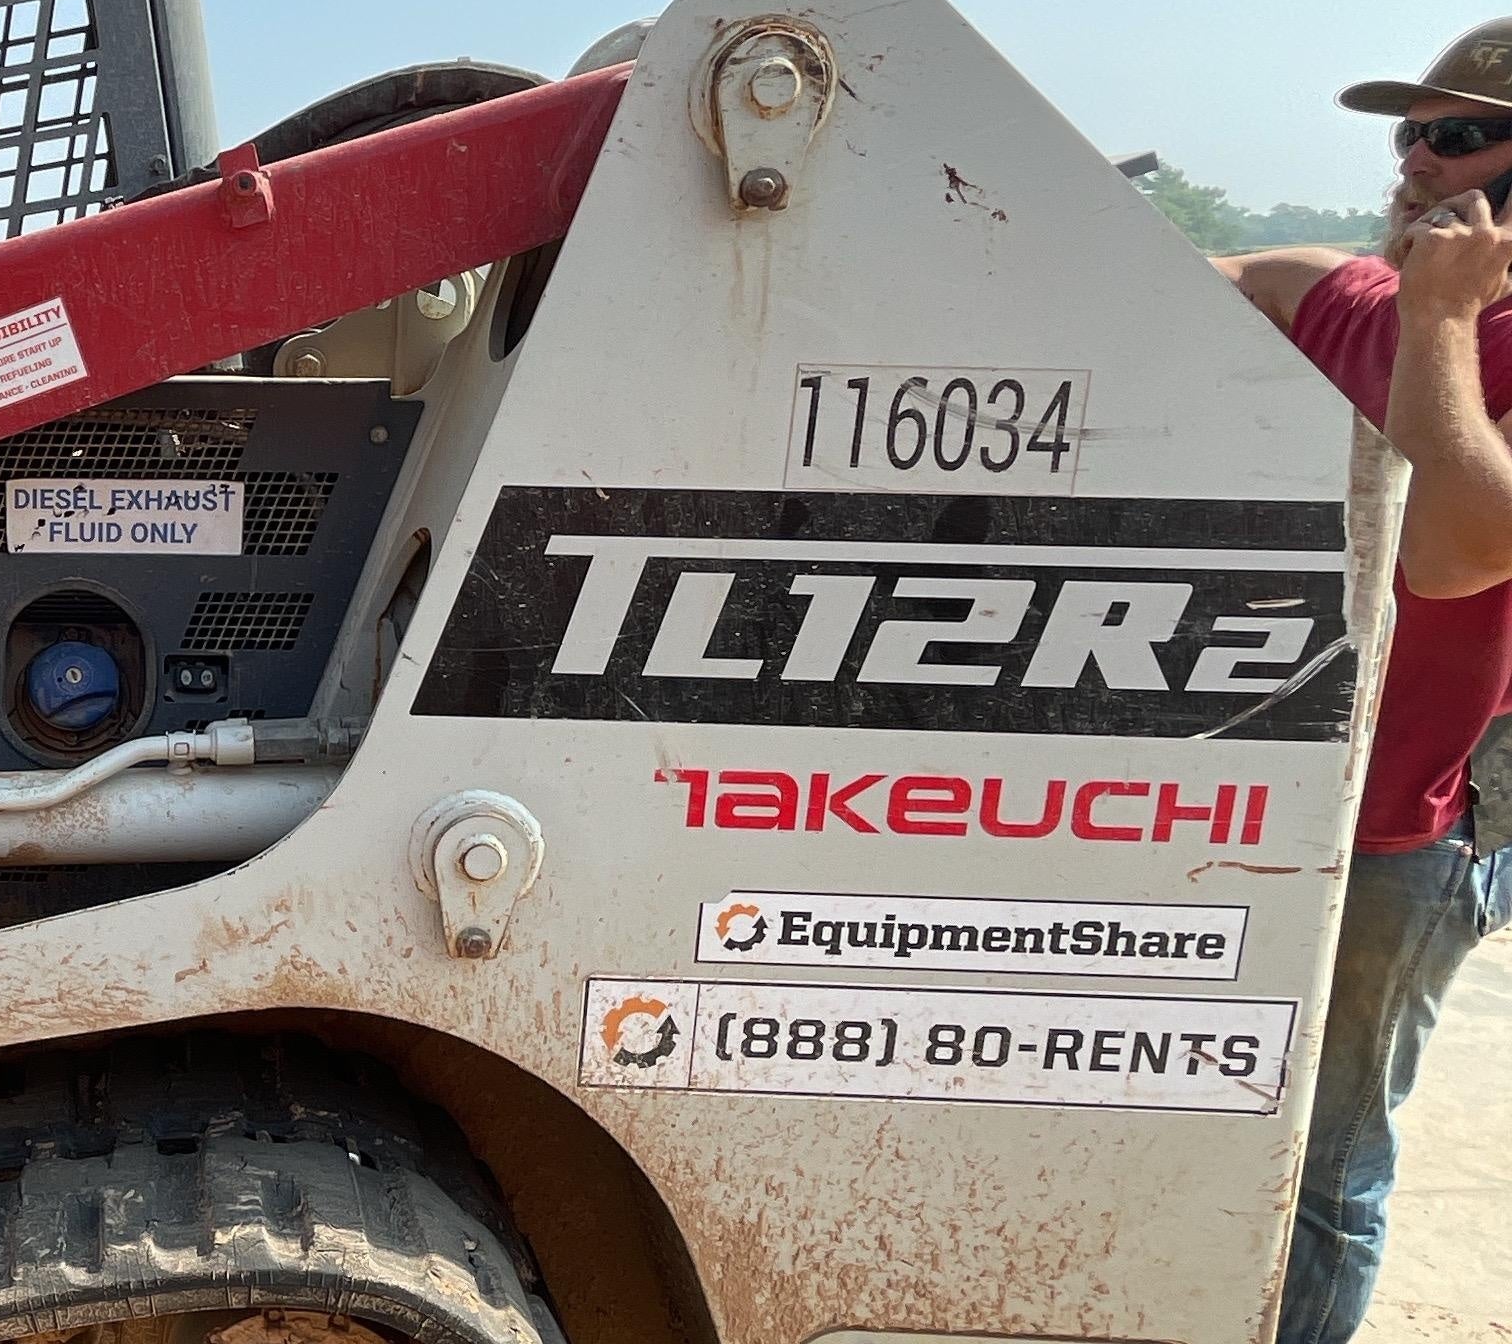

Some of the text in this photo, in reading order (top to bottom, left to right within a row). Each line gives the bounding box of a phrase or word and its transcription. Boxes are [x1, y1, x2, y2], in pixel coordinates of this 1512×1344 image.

[17, 341, 48, 361] START
[48, 335, 63, 349] UP
[0, 357, 53, 383] REFUELING
[30, 365, 79, 390] CLEANING
[799, 373, 1072, 474] 116034
[13, 488, 236, 513] DIESEL EXHAUST
[48, 520, 198, 545] FLUID ONLY
[544, 535, 1316, 694] TL12R2
[776, 910, 1227, 962] EquipmentShare
[716, 1013, 1261, 1078] (888) 80-RENTS
